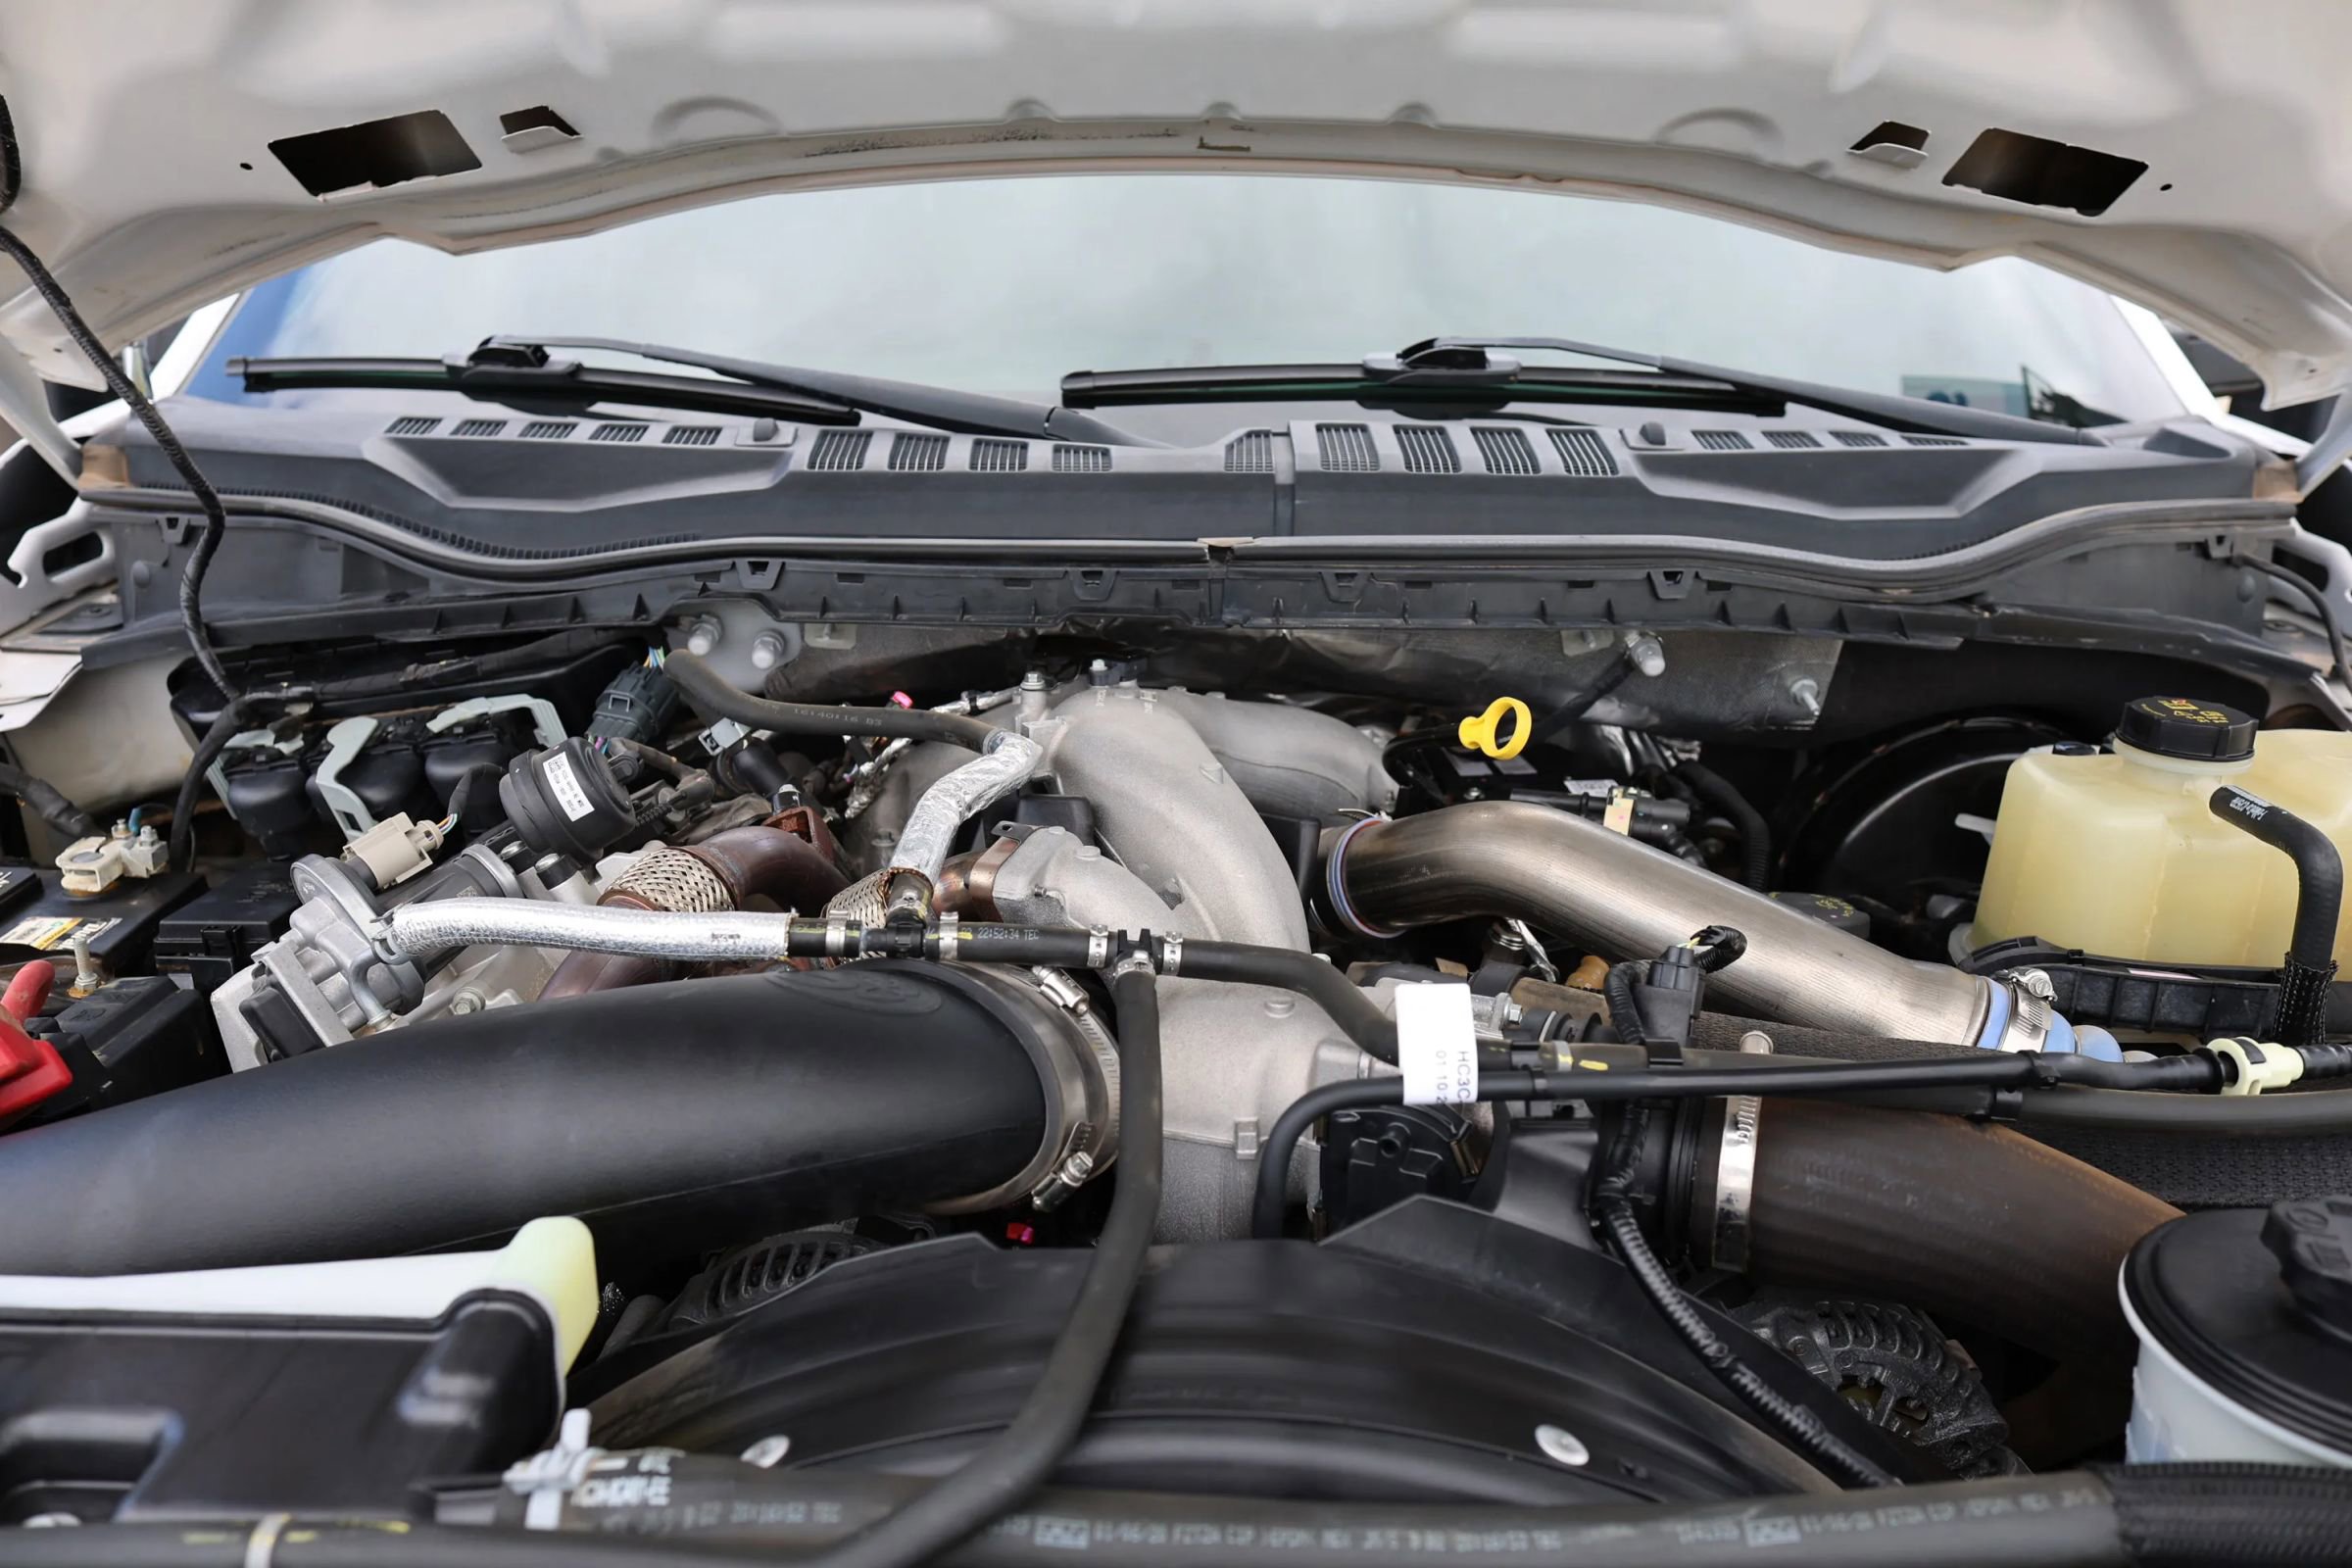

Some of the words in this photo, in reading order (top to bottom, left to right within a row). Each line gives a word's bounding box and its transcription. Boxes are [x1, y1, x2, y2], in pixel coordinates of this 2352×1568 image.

[978, 927, 1019, 941] 22:52:34
[1024, 928, 1040, 941] TEC
[1457, 1051, 1472, 1103] HC3C
